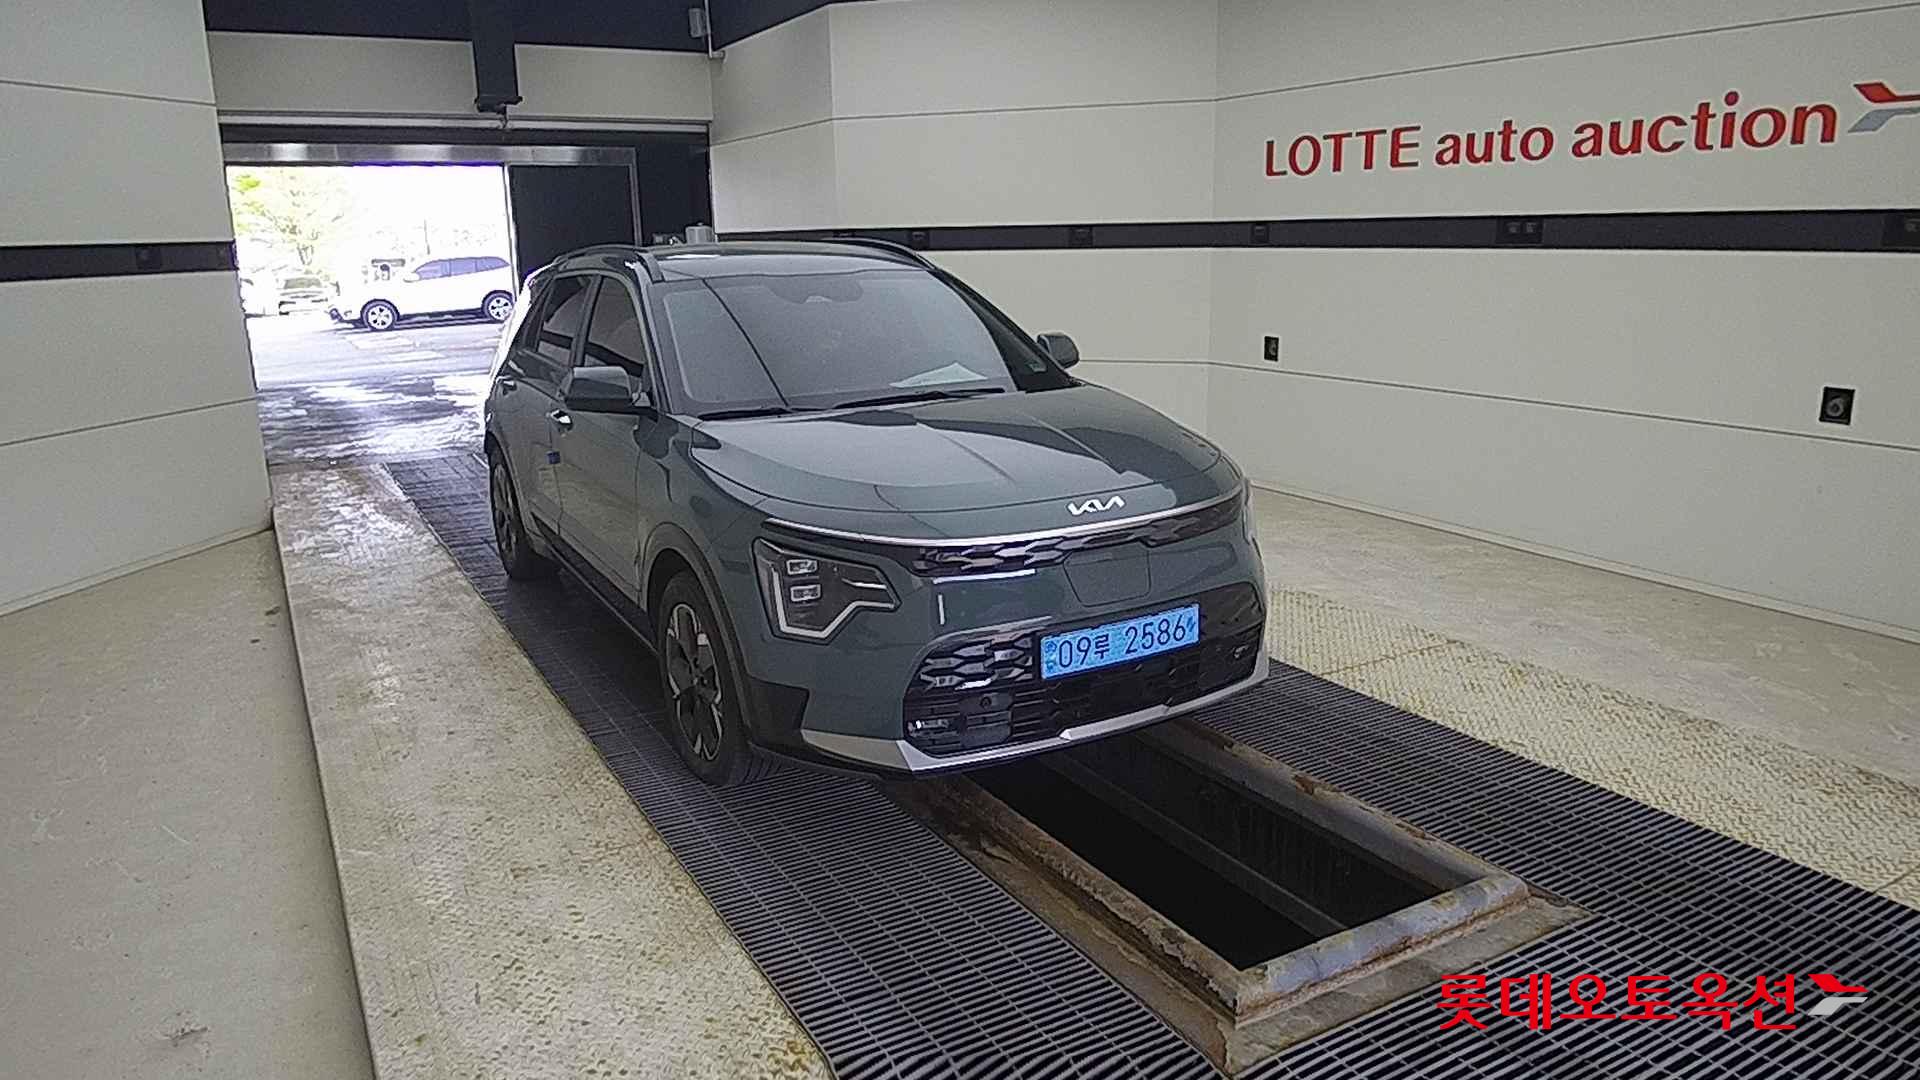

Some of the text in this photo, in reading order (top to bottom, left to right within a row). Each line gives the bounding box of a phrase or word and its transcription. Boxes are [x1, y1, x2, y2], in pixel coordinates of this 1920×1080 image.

[1265, 91, 1839, 176] LOTTE auto auction
[1058, 633, 1110, 668] 09루
[1124, 614, 1186, 655] 2586
